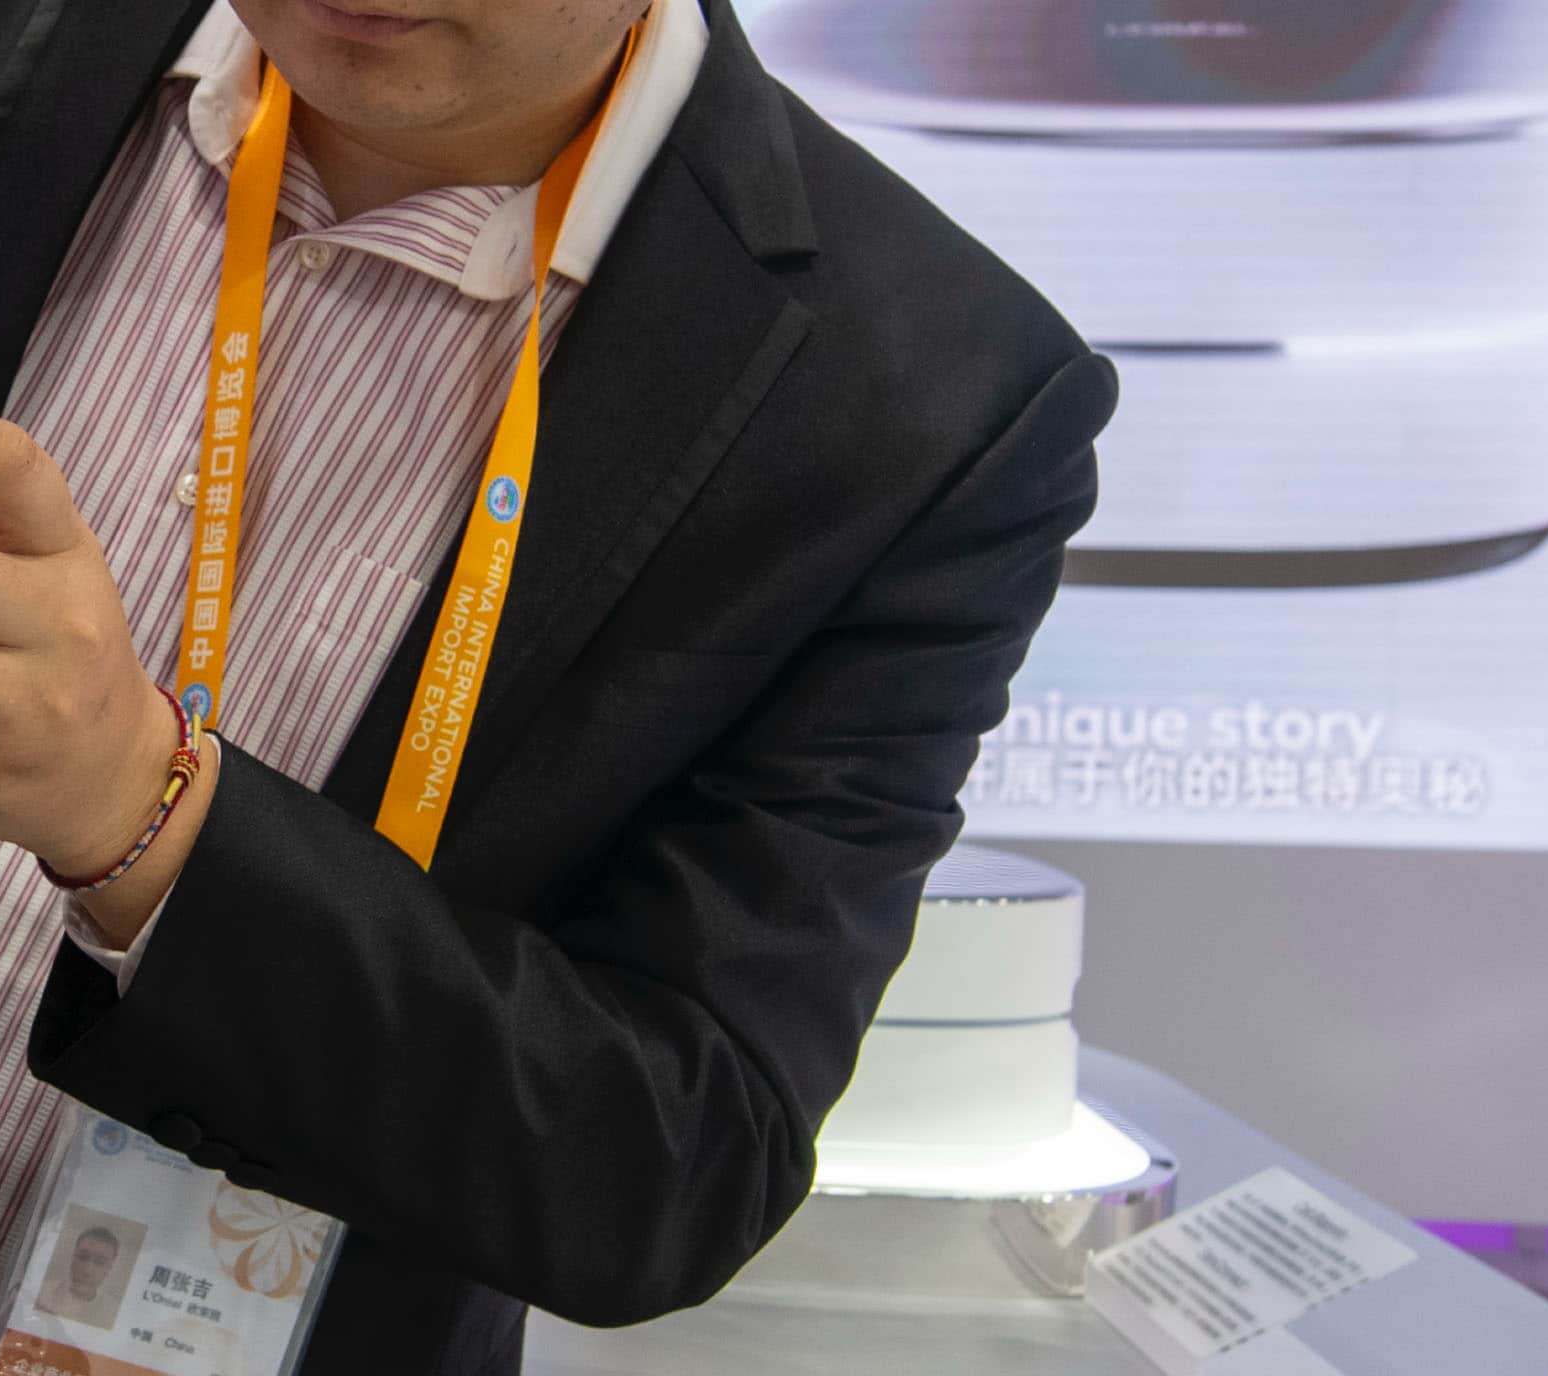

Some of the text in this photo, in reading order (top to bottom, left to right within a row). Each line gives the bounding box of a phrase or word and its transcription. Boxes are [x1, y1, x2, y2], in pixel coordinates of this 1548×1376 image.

[188, 330, 250, 672] 中国国际进口博览会
[410, 583, 477, 753] IMPORT EXPO
[415, 537, 511, 814] CHINA INTERNATIONAL
[979, 689, 1386, 762] nique story
